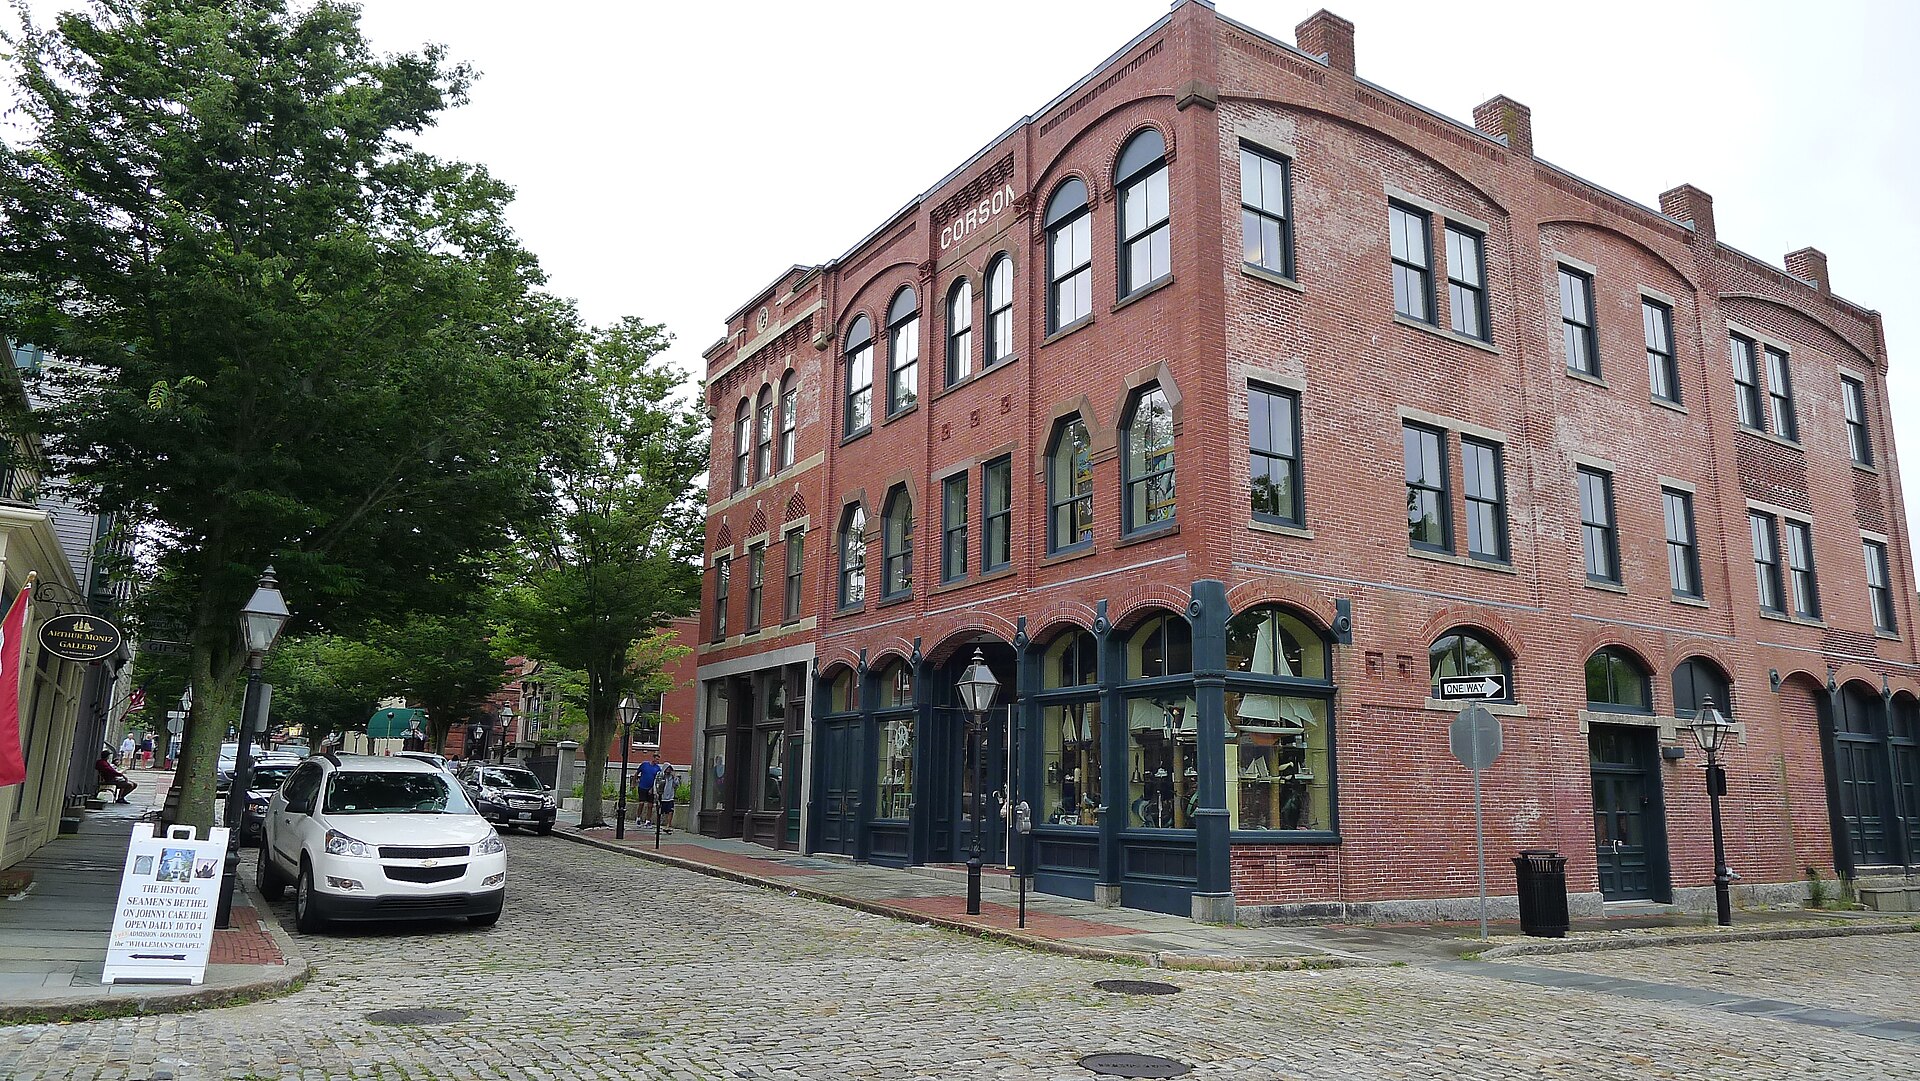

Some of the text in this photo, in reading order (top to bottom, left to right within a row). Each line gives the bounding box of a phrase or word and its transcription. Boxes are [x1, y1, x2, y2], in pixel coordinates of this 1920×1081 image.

[940, 184, 1015, 250] CORSON
[48, 630, 114, 643] ARTHUR MONIZ
[59, 640, 98, 651] GALLERY
[1446, 683, 1484, 694] ONE WAY
[142, 884, 200, 895] THE HISTORIC
[126, 896, 209, 908] SEAMEN'S BETHEL
[123, 908, 208, 920] ON JOHNNY CAKE HILL
[124, 920, 203, 930] OPEN DAILY 10 TO 4
[125, 940, 174, 949] "WHALEMAN'S
[174, 941, 205, 949] CHAPEL"
